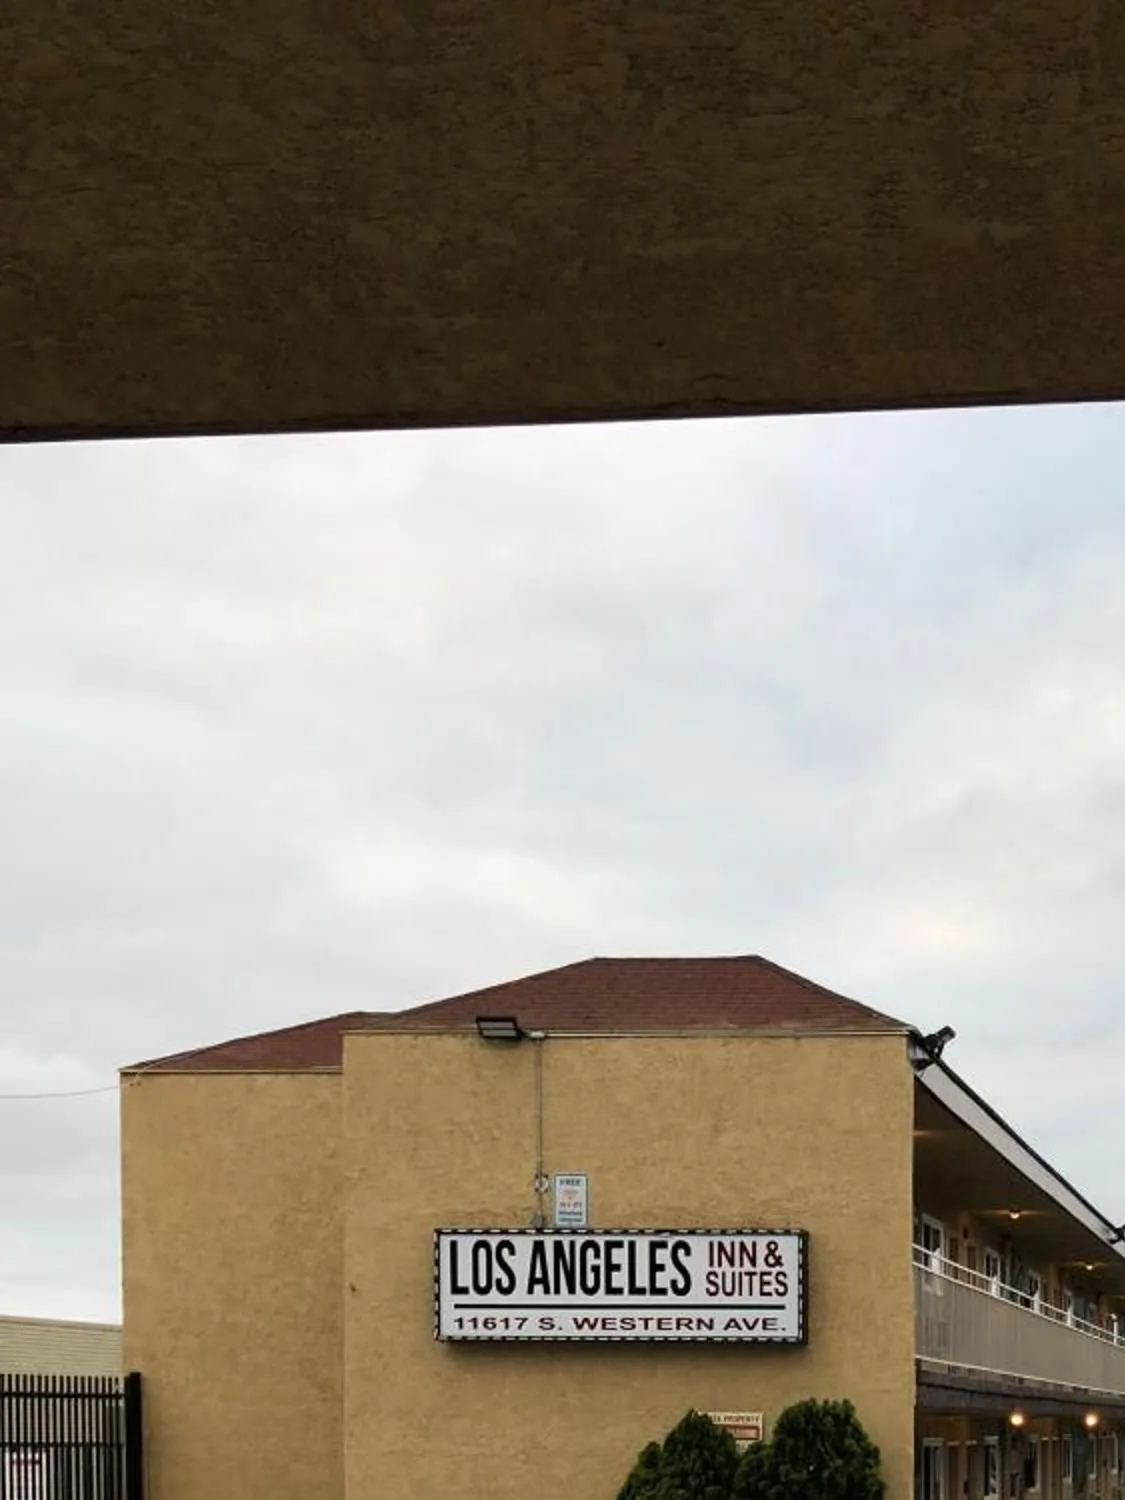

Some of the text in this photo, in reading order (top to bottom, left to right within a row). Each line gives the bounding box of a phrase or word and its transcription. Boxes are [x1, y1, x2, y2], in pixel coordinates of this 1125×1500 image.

[708, 1240, 784, 1268] INN &
[450, 1239, 692, 1297] LOS ANGELES
[706, 1271, 789, 1297] SUITES
[453, 1317, 786, 1331] 11617 S. WESTERN AVE.
